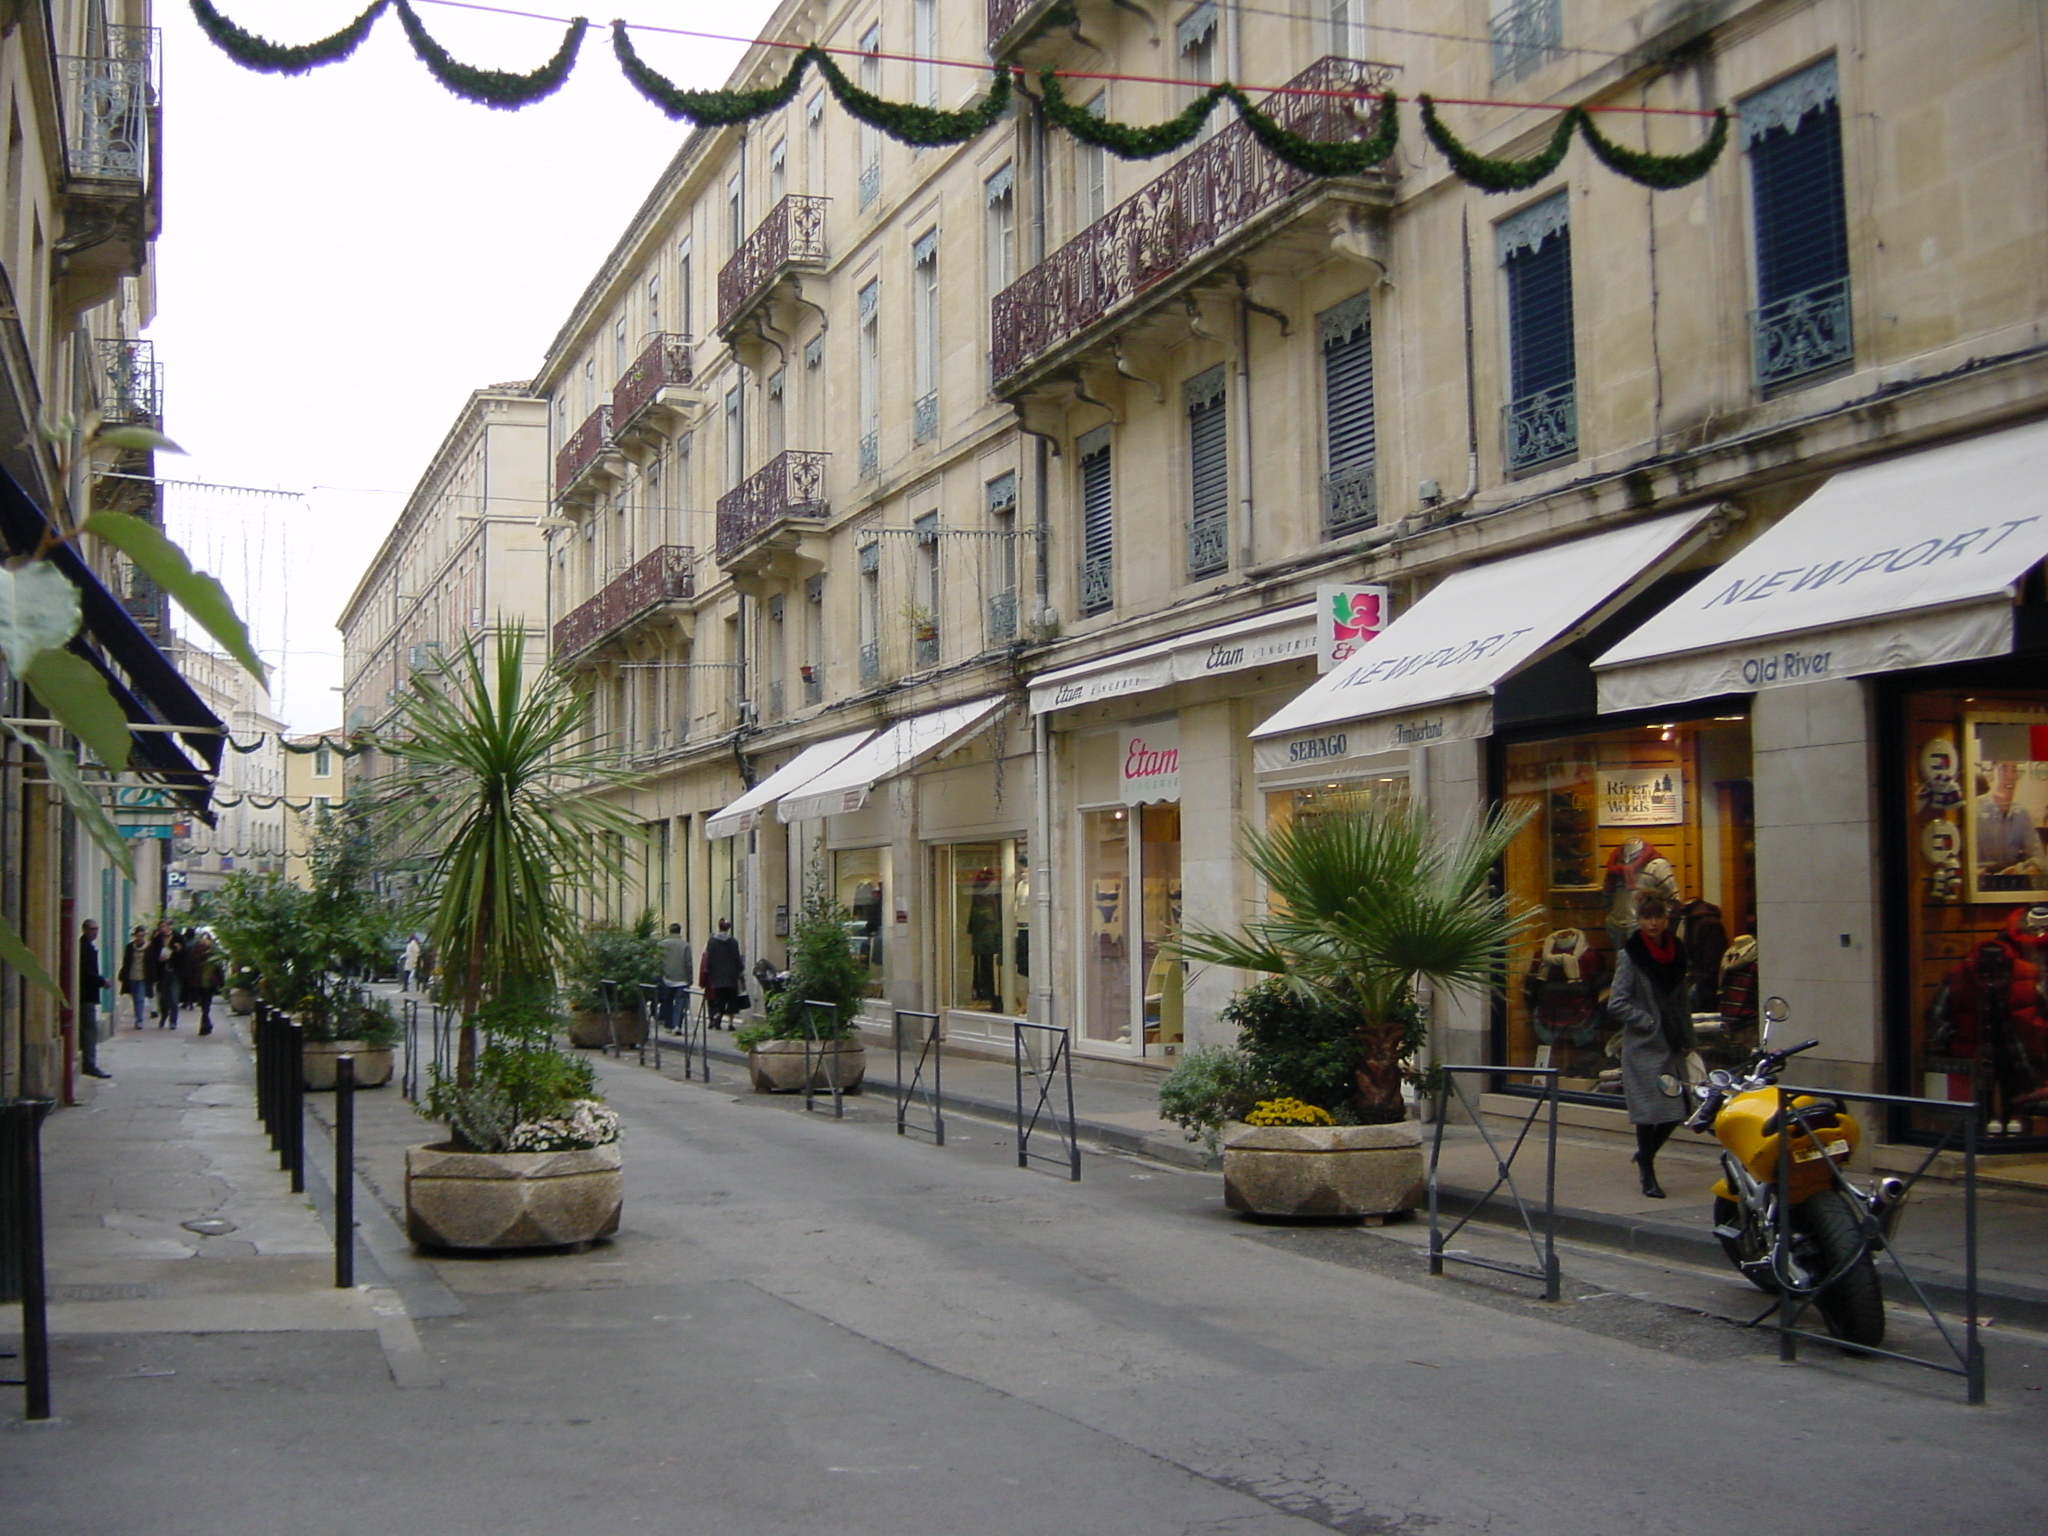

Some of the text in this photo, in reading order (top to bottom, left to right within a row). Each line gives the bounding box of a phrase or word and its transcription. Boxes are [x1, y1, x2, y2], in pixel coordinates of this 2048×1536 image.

[1702, 515, 2041, 610] NEWPORT
[1206, 636, 1317, 670] Etam LINGERIE
[1330, 626, 1535, 692] NEWPORT
[1743, 652, 1832, 685] Old River
[1055, 682, 1084, 706] Etam
[1395, 716, 1443, 744] Timberland
[1125, 738, 1179, 779] Etam
[1289, 733, 1348, 763] SEBAGO
[168, 872, 180, 886] P
